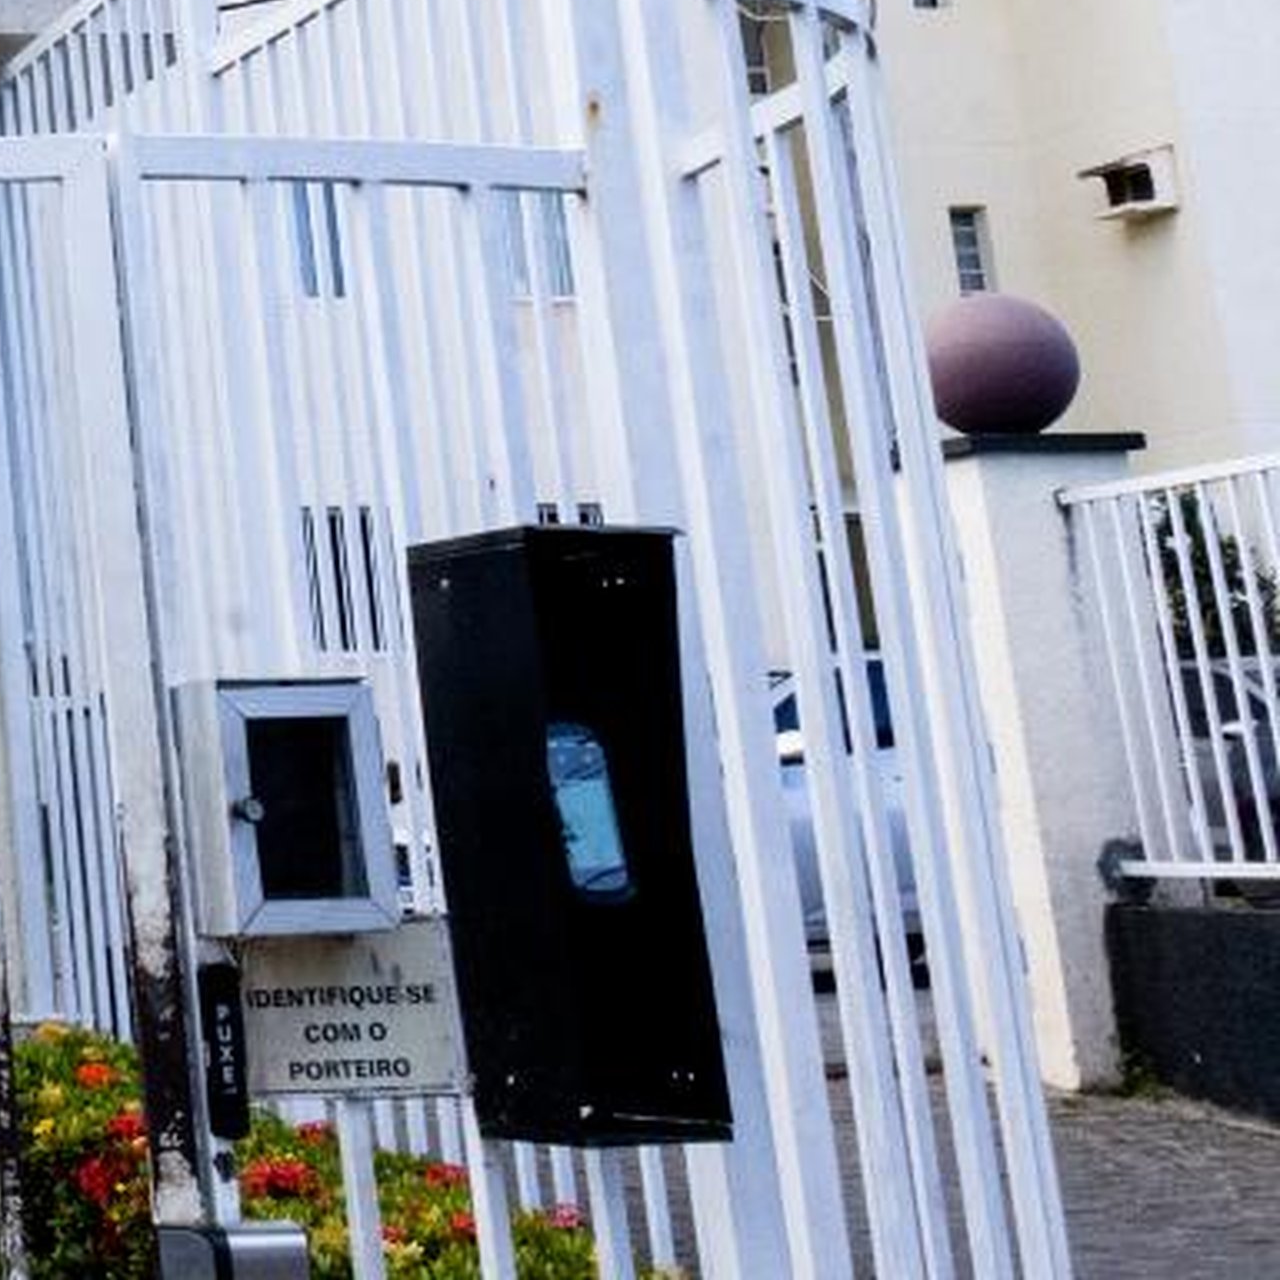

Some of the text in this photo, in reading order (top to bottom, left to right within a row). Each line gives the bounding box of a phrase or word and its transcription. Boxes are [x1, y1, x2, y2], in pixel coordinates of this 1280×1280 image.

[304, 1022, 387, 1044] COM O
[289, 1057, 412, 1081] PORTEIRO
